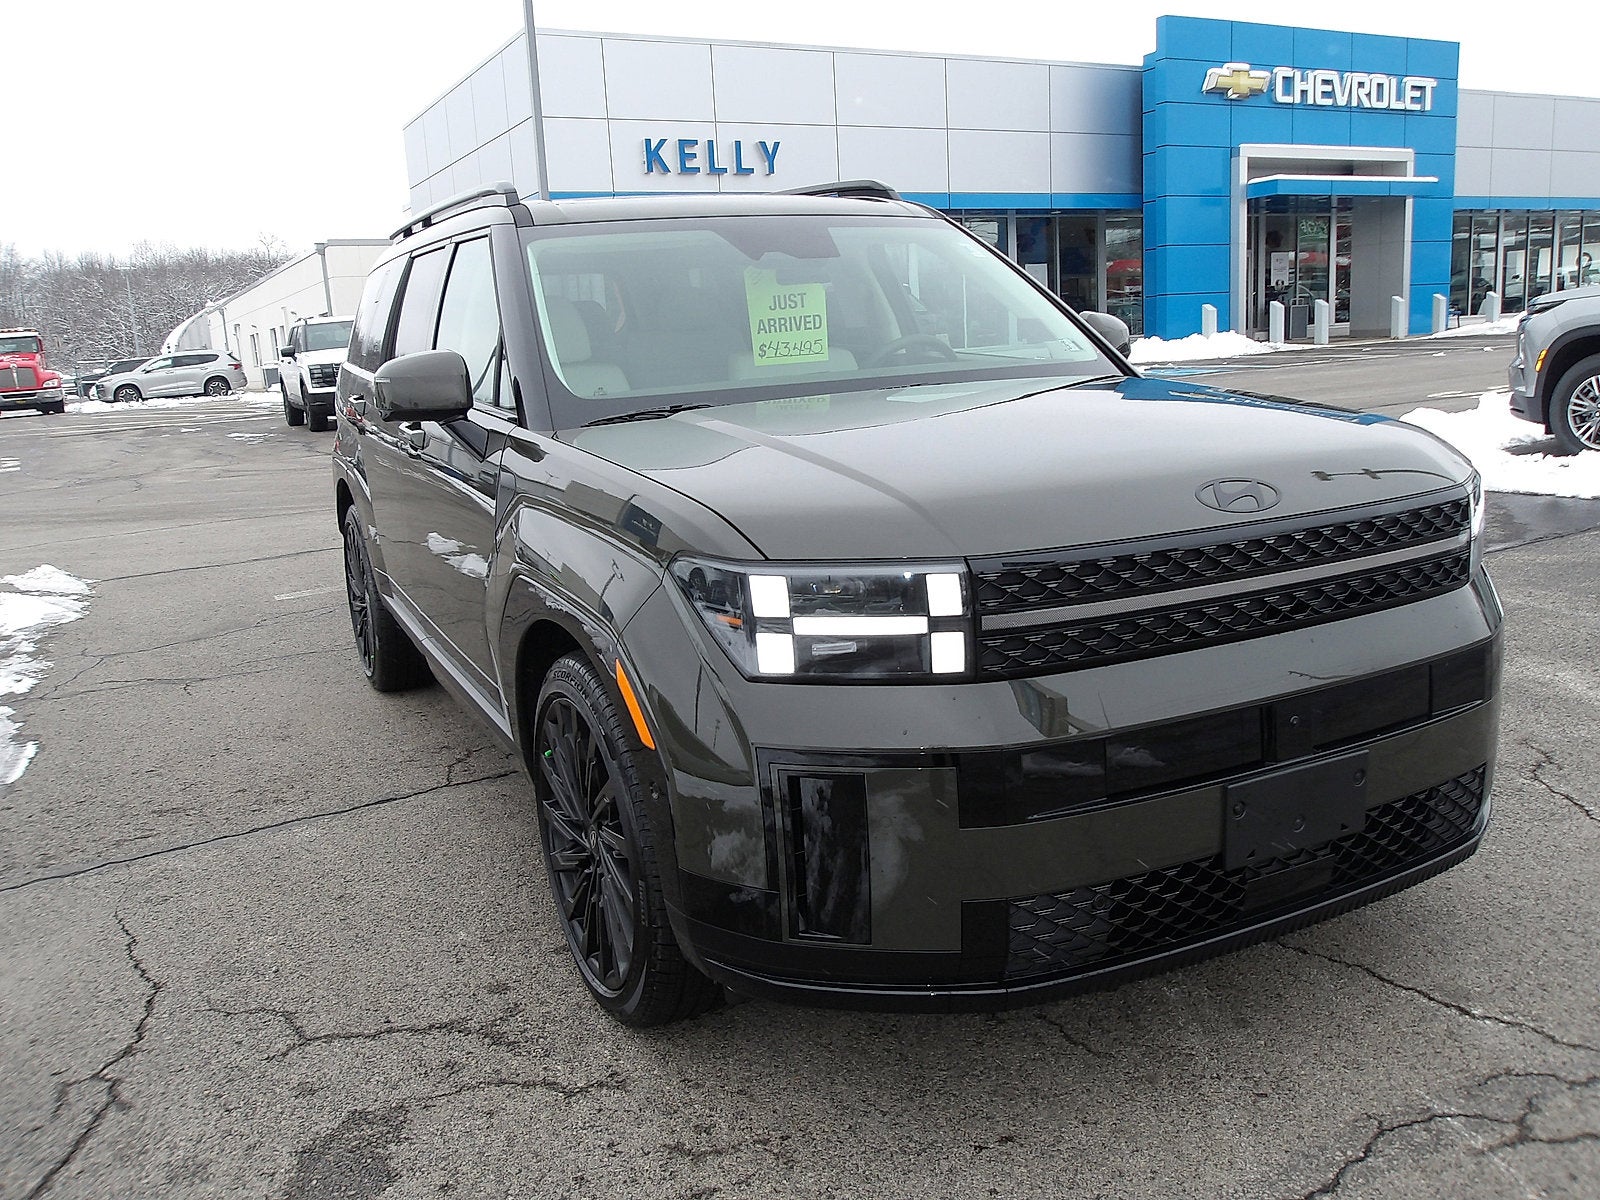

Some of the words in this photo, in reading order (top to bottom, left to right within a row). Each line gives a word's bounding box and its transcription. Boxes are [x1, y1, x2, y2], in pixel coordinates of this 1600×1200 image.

[1273, 67, 1437, 112] CHEVROLET
[643, 138, 780, 175] KELLY
[768, 292, 807, 311] JUST
[757, 314, 822, 334] ARRIVED
